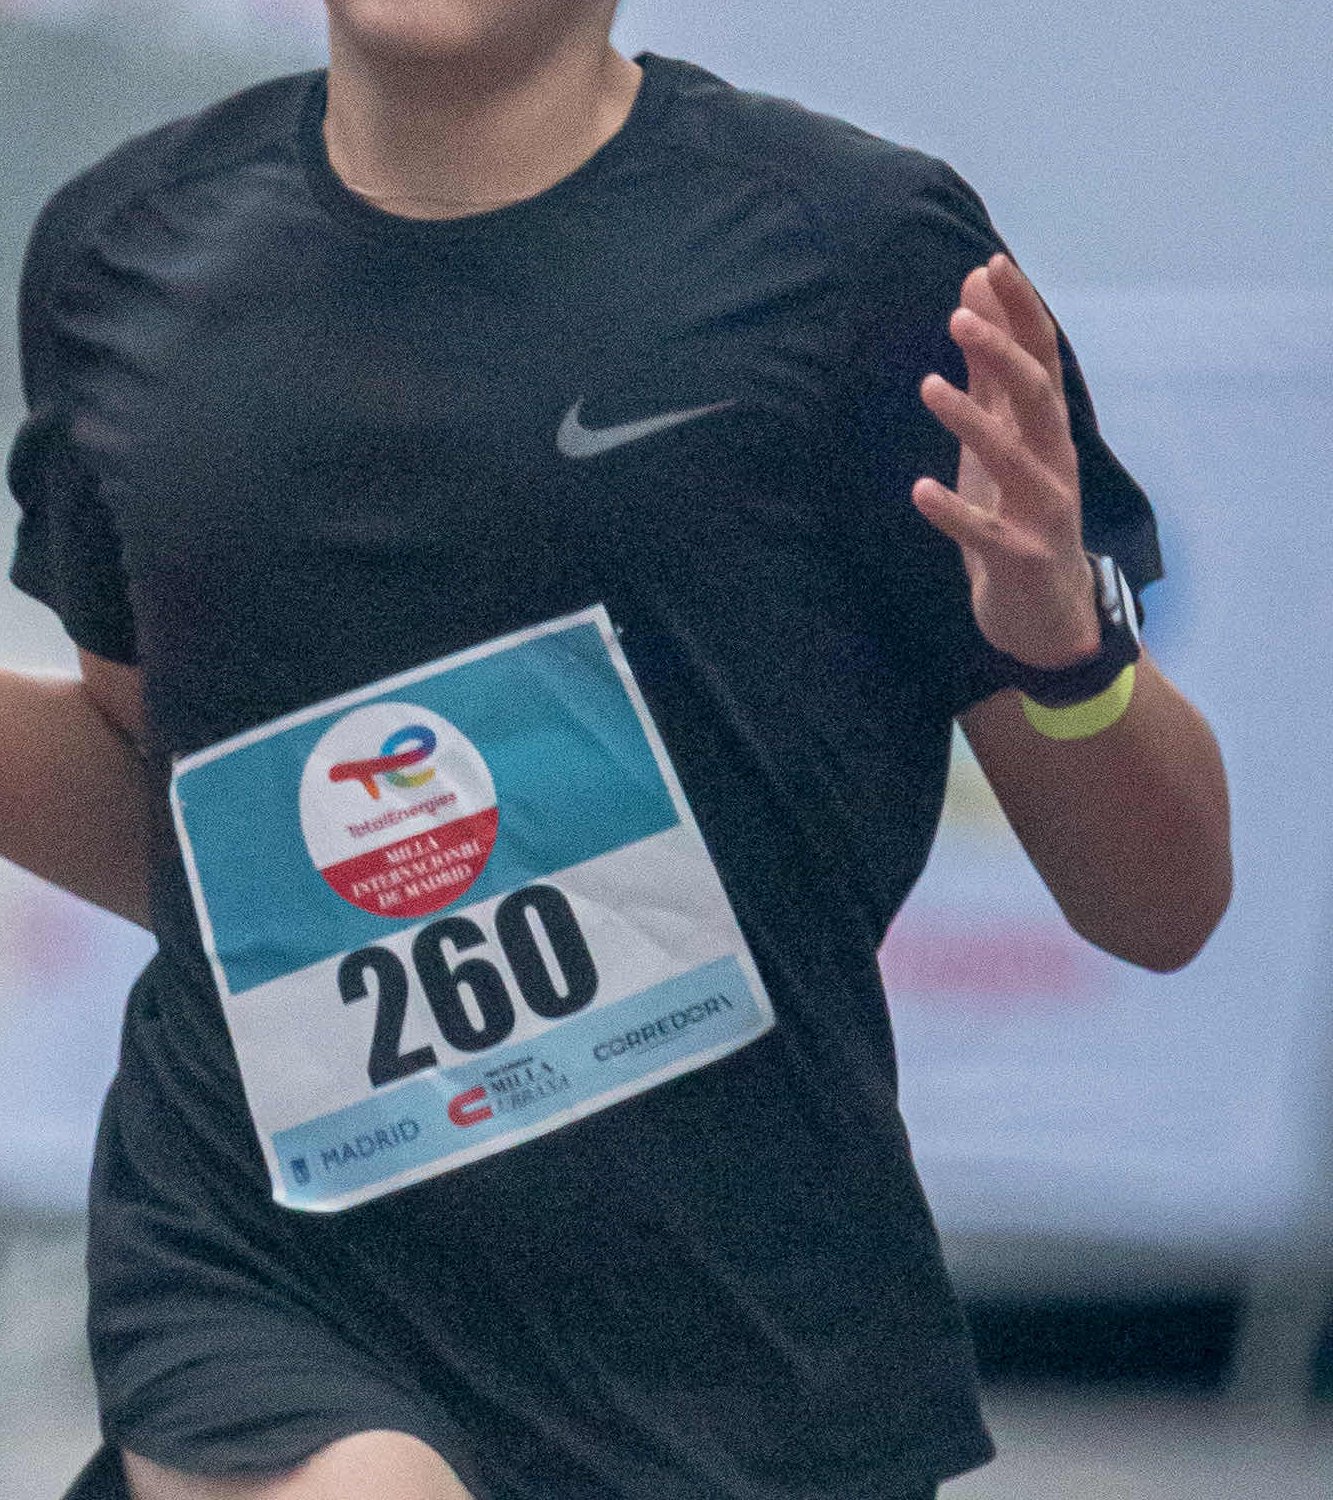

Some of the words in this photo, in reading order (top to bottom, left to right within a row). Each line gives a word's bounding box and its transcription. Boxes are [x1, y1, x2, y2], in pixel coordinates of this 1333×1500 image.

[386, 836, 439, 863] MILLA
[403, 863, 473, 899] MADRID
[337, 883, 599, 1088] 260
[320, 1118, 421, 1171] MADRID
